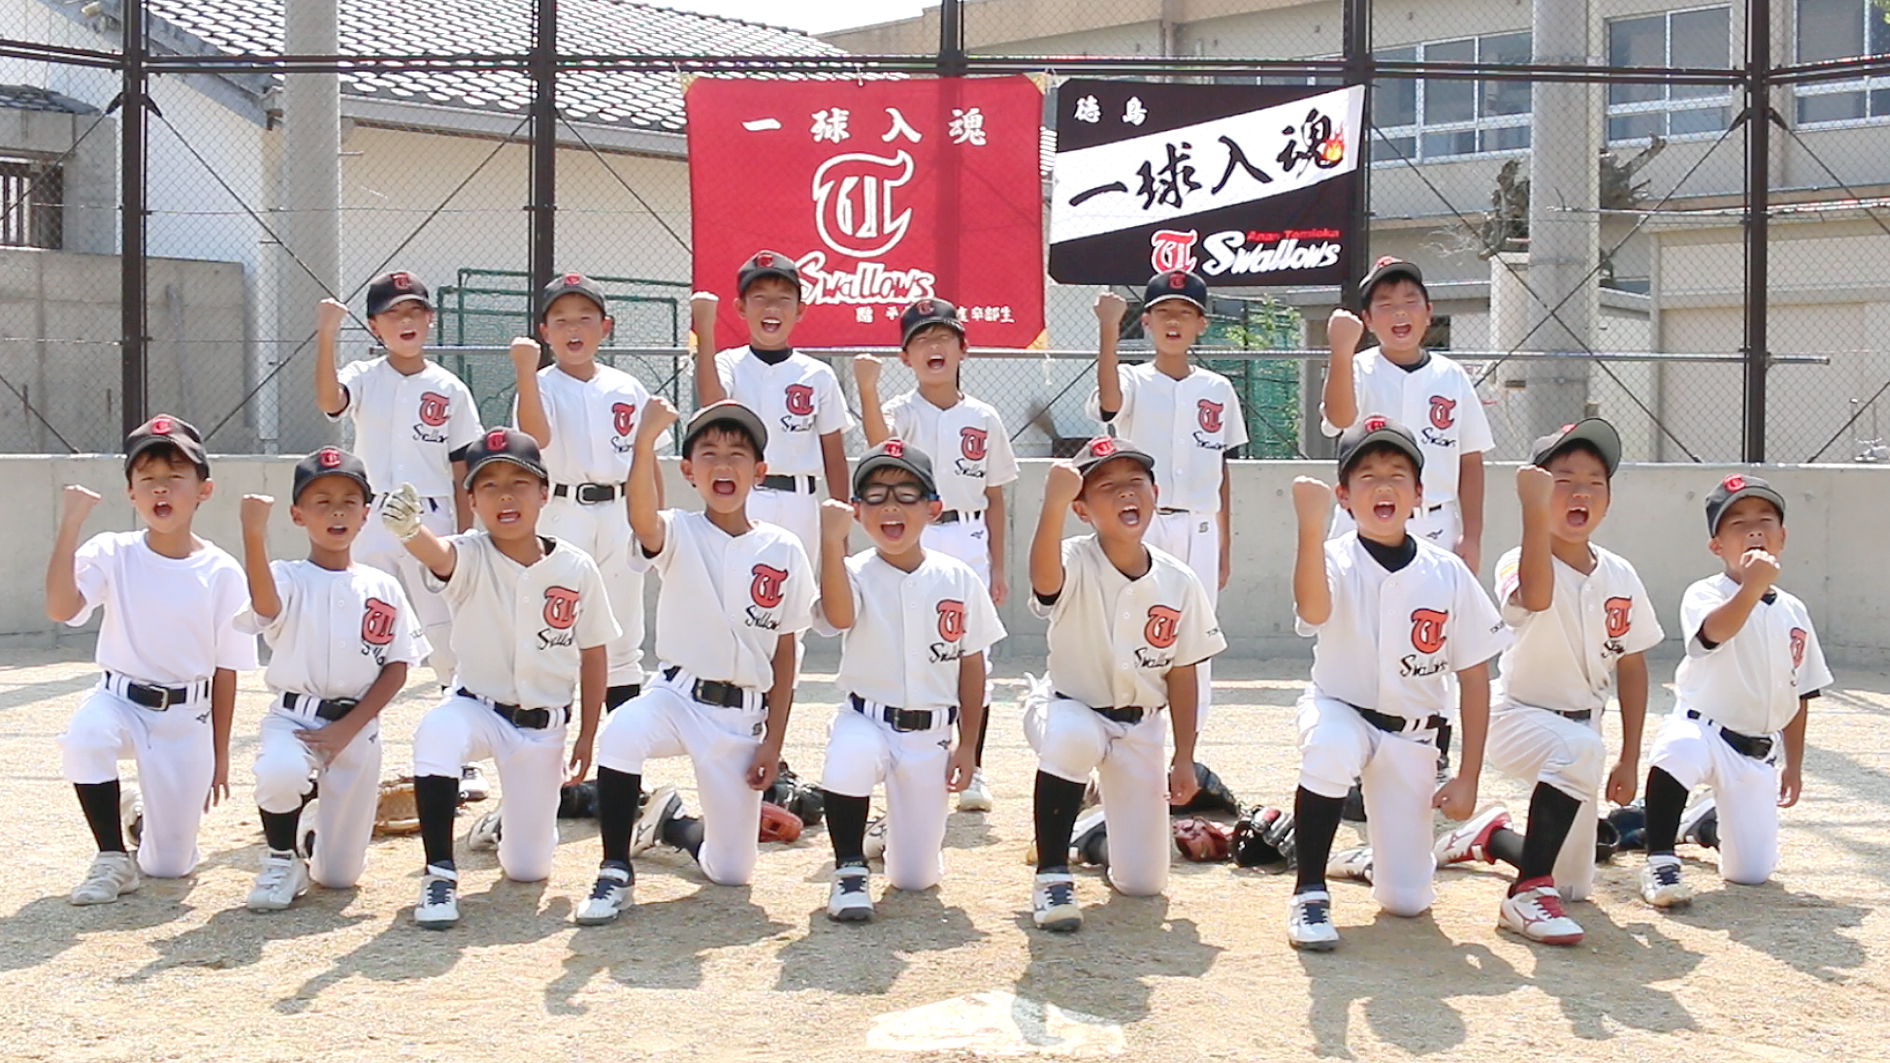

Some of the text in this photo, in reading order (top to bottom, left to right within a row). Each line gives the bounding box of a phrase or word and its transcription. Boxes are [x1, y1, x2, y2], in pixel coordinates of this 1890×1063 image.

[741, 107, 988, 146] 一球入魂
[1074, 95, 1148, 126] 徳島
[1069, 108, 1343, 210] 一球入魂
[1201, 231, 1342, 276] Swallows
[1246, 230, 1281, 242] Anan
[795, 250, 936, 305] Swallows
